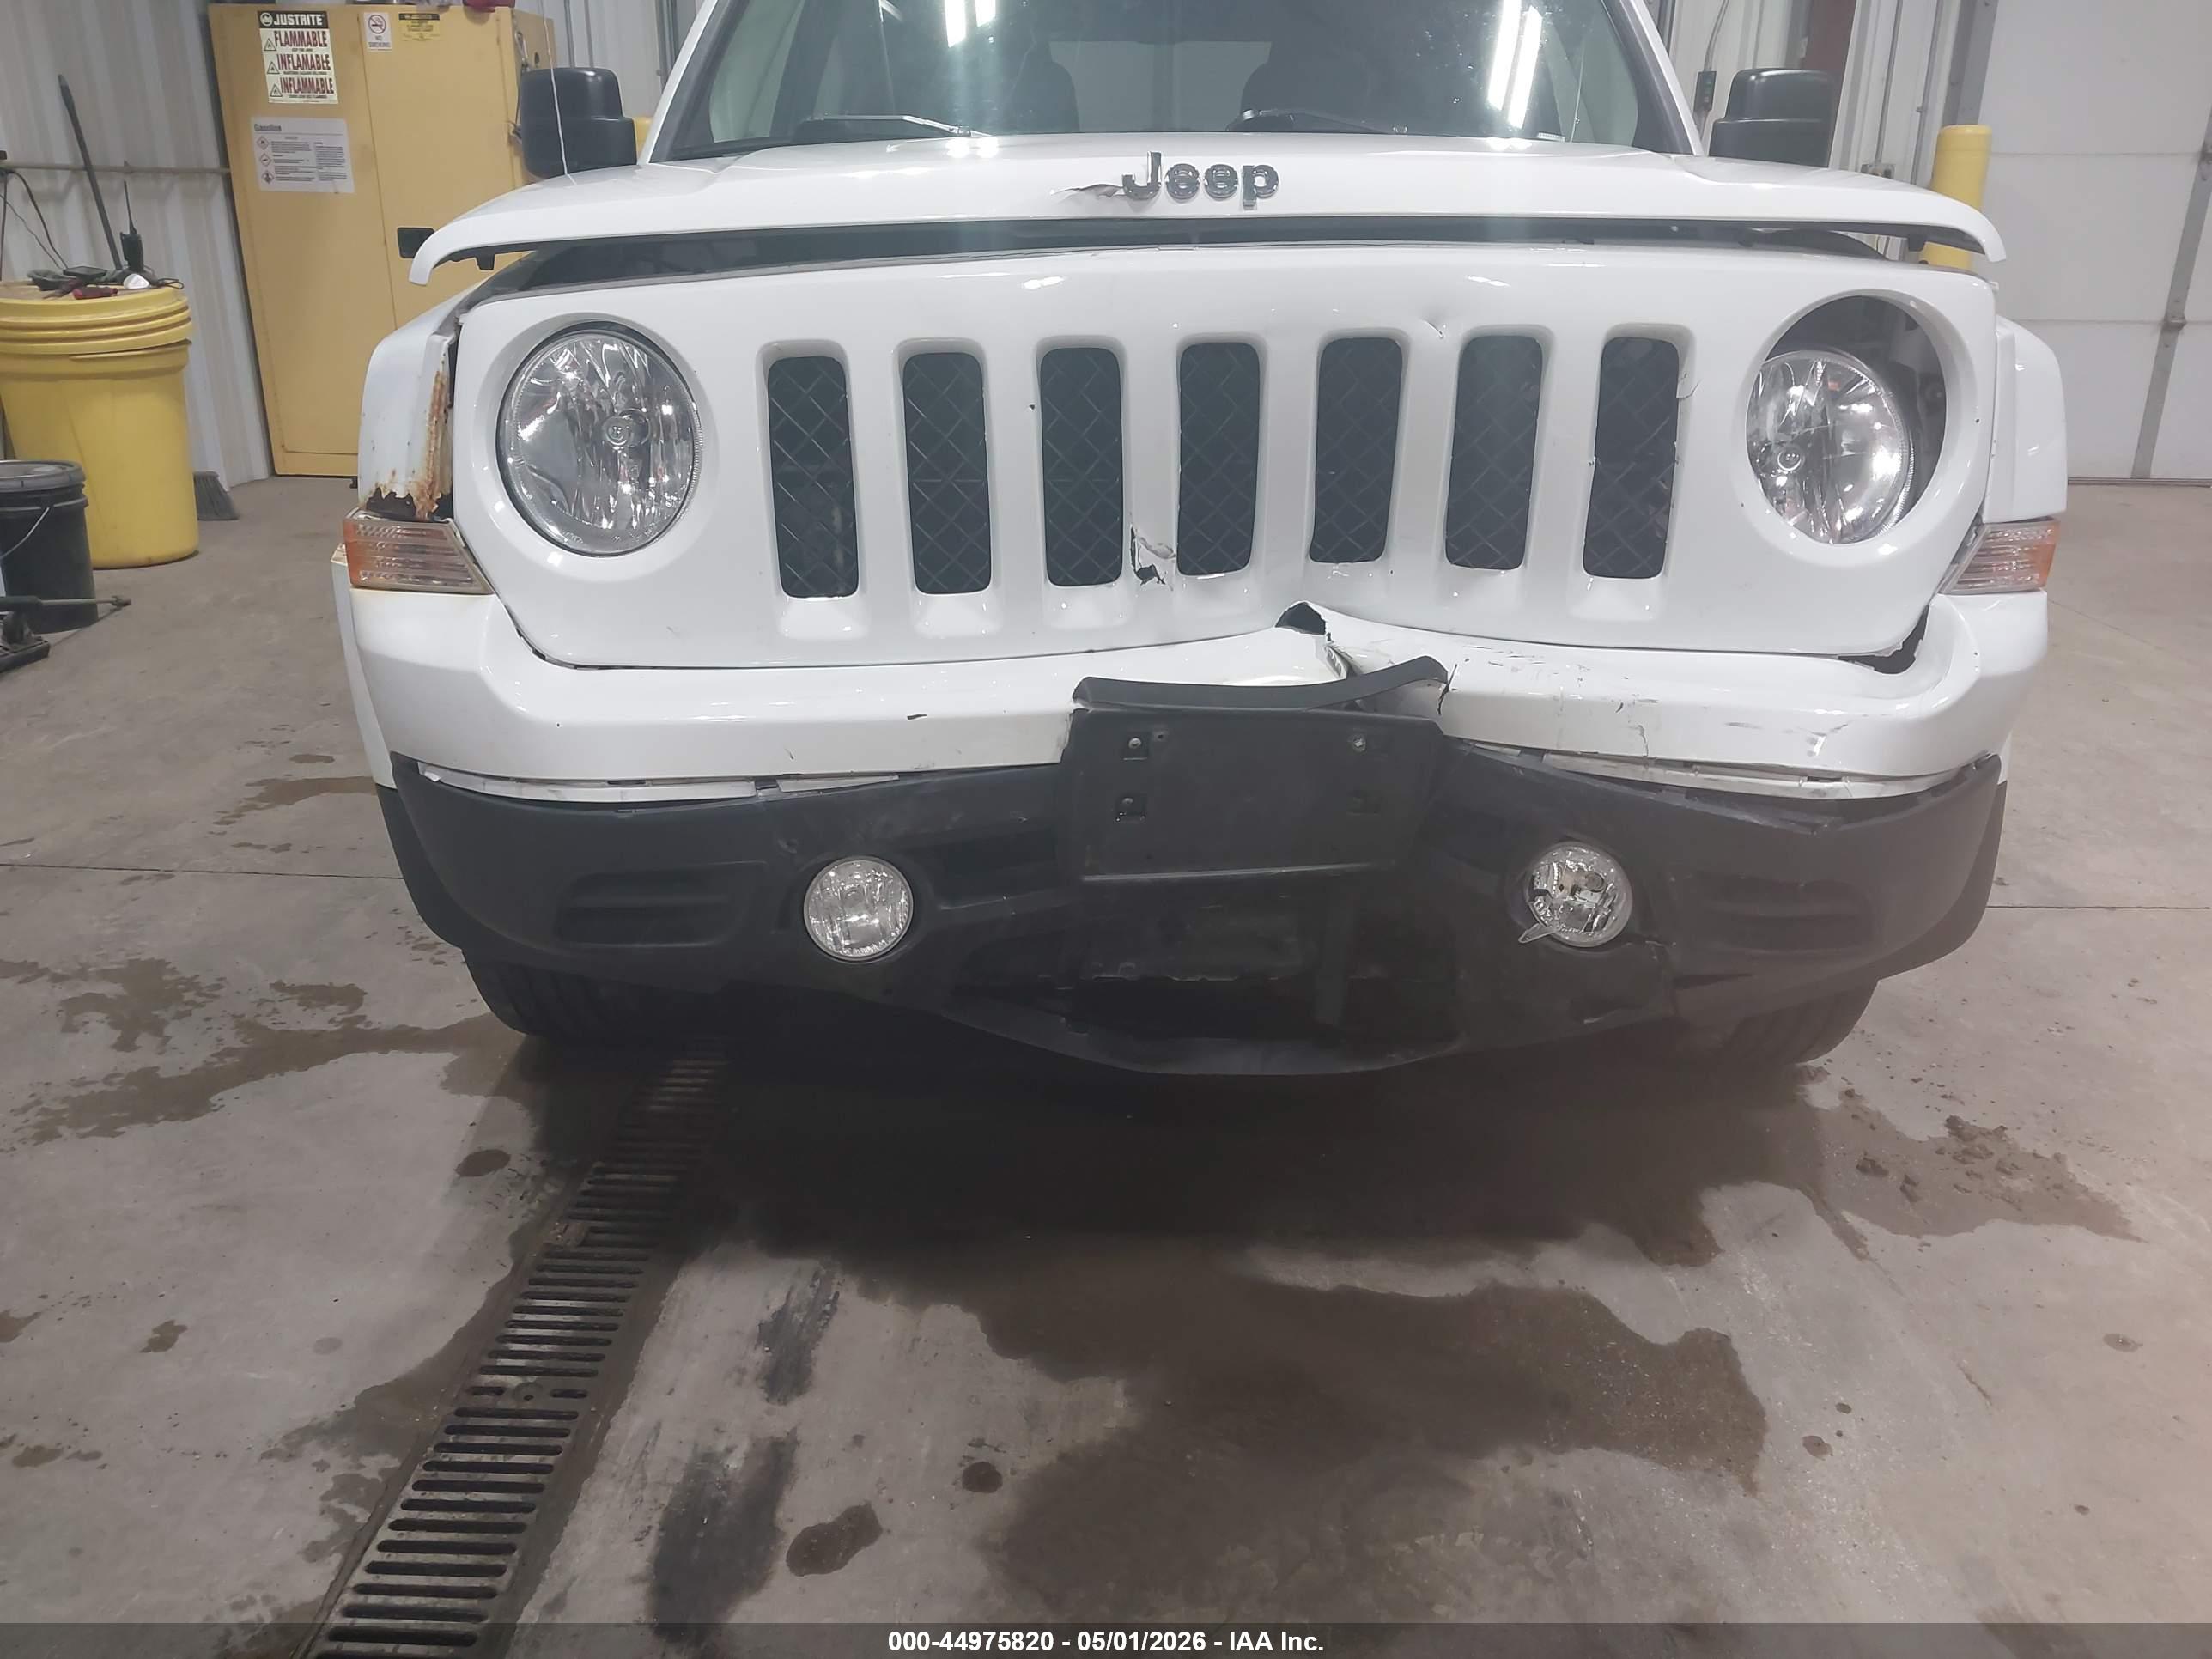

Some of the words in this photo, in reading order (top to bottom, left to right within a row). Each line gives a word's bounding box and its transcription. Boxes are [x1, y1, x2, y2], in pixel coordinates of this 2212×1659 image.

[273, 14, 323, 26] JUSTRITE
[274, 30, 328, 47] FLAMMABLE
[276, 53, 331, 70] INFLAMABLE
[280, 76, 335, 94] INFLAMMABLE
[1121, 150, 1279, 210] Jeep
